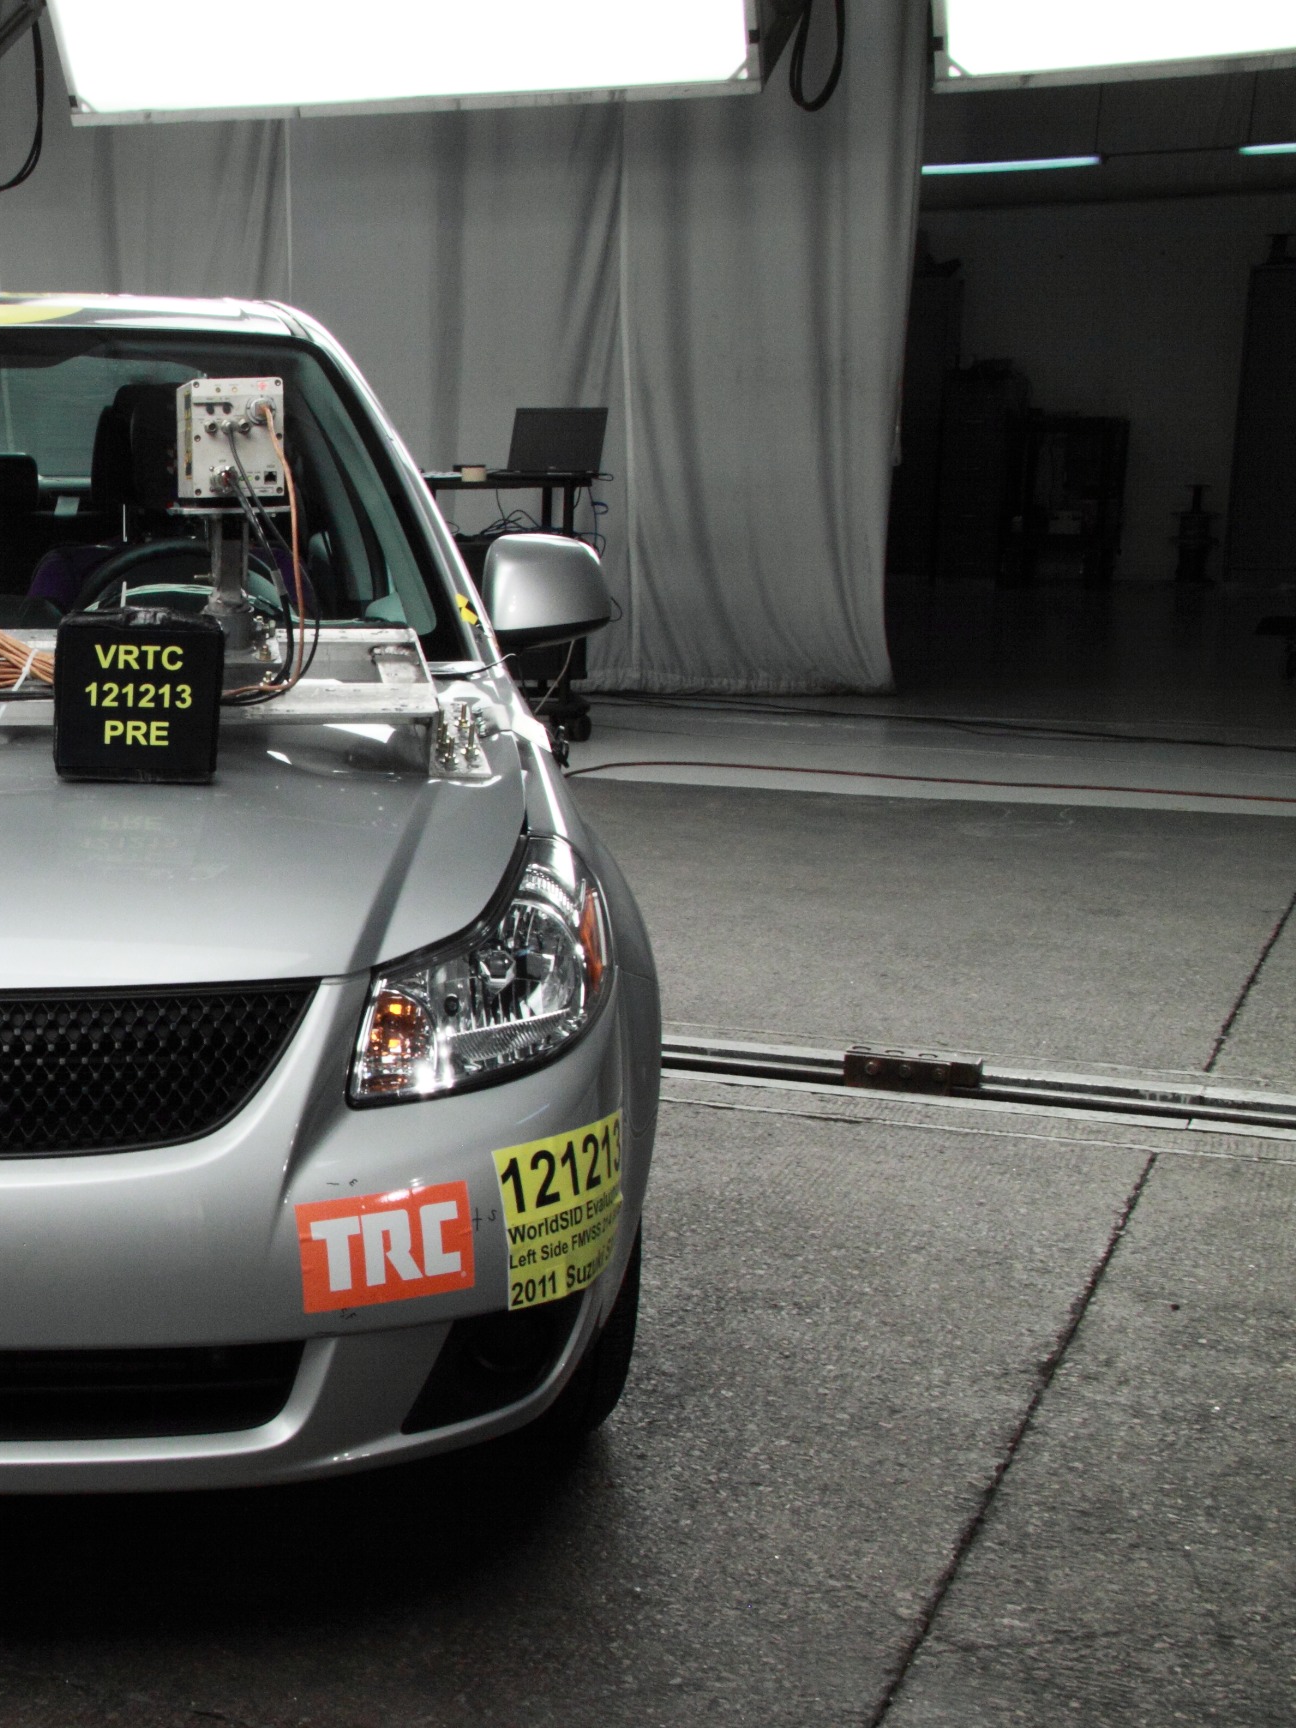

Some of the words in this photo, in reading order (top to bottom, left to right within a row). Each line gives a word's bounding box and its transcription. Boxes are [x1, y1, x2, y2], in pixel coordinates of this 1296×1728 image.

[95, 644, 184, 671] VRTC
[85, 682, 192, 709] 121213
[104, 720, 170, 746] PRE
[501, 1117, 621, 1214] 121213
[508, 1204, 584, 1245] WorldSID
[309, 1200, 462, 1293] TRC
[509, 1250, 537, 1270] Left
[541, 1241, 569, 1262] Side
[571, 1222, 602, 1251] FMVSS
[511, 1270, 558, 1307] 2011
